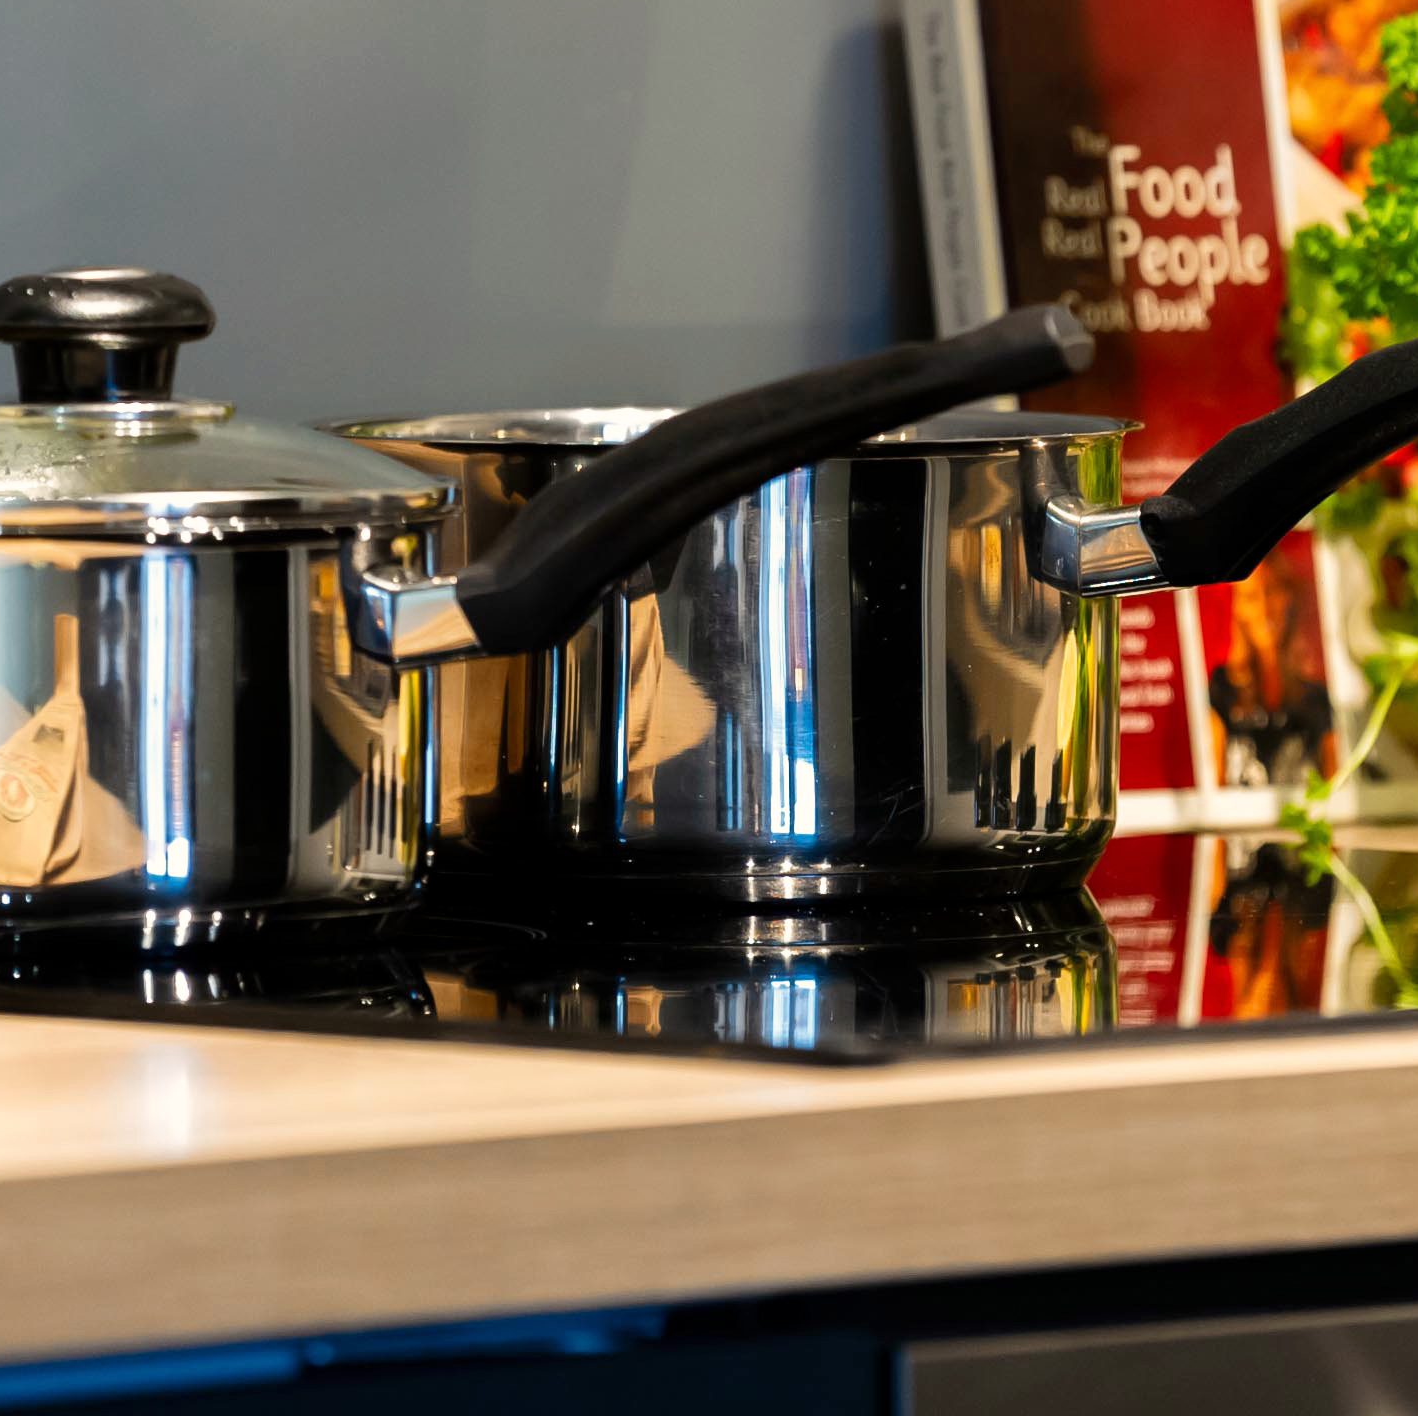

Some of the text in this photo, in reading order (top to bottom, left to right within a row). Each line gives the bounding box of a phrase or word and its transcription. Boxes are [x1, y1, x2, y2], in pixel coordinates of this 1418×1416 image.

[1045, 144, 1241, 218] Real Food
[1042, 215, 1270, 309] Real People
[1133, 288, 1211, 332] Book
